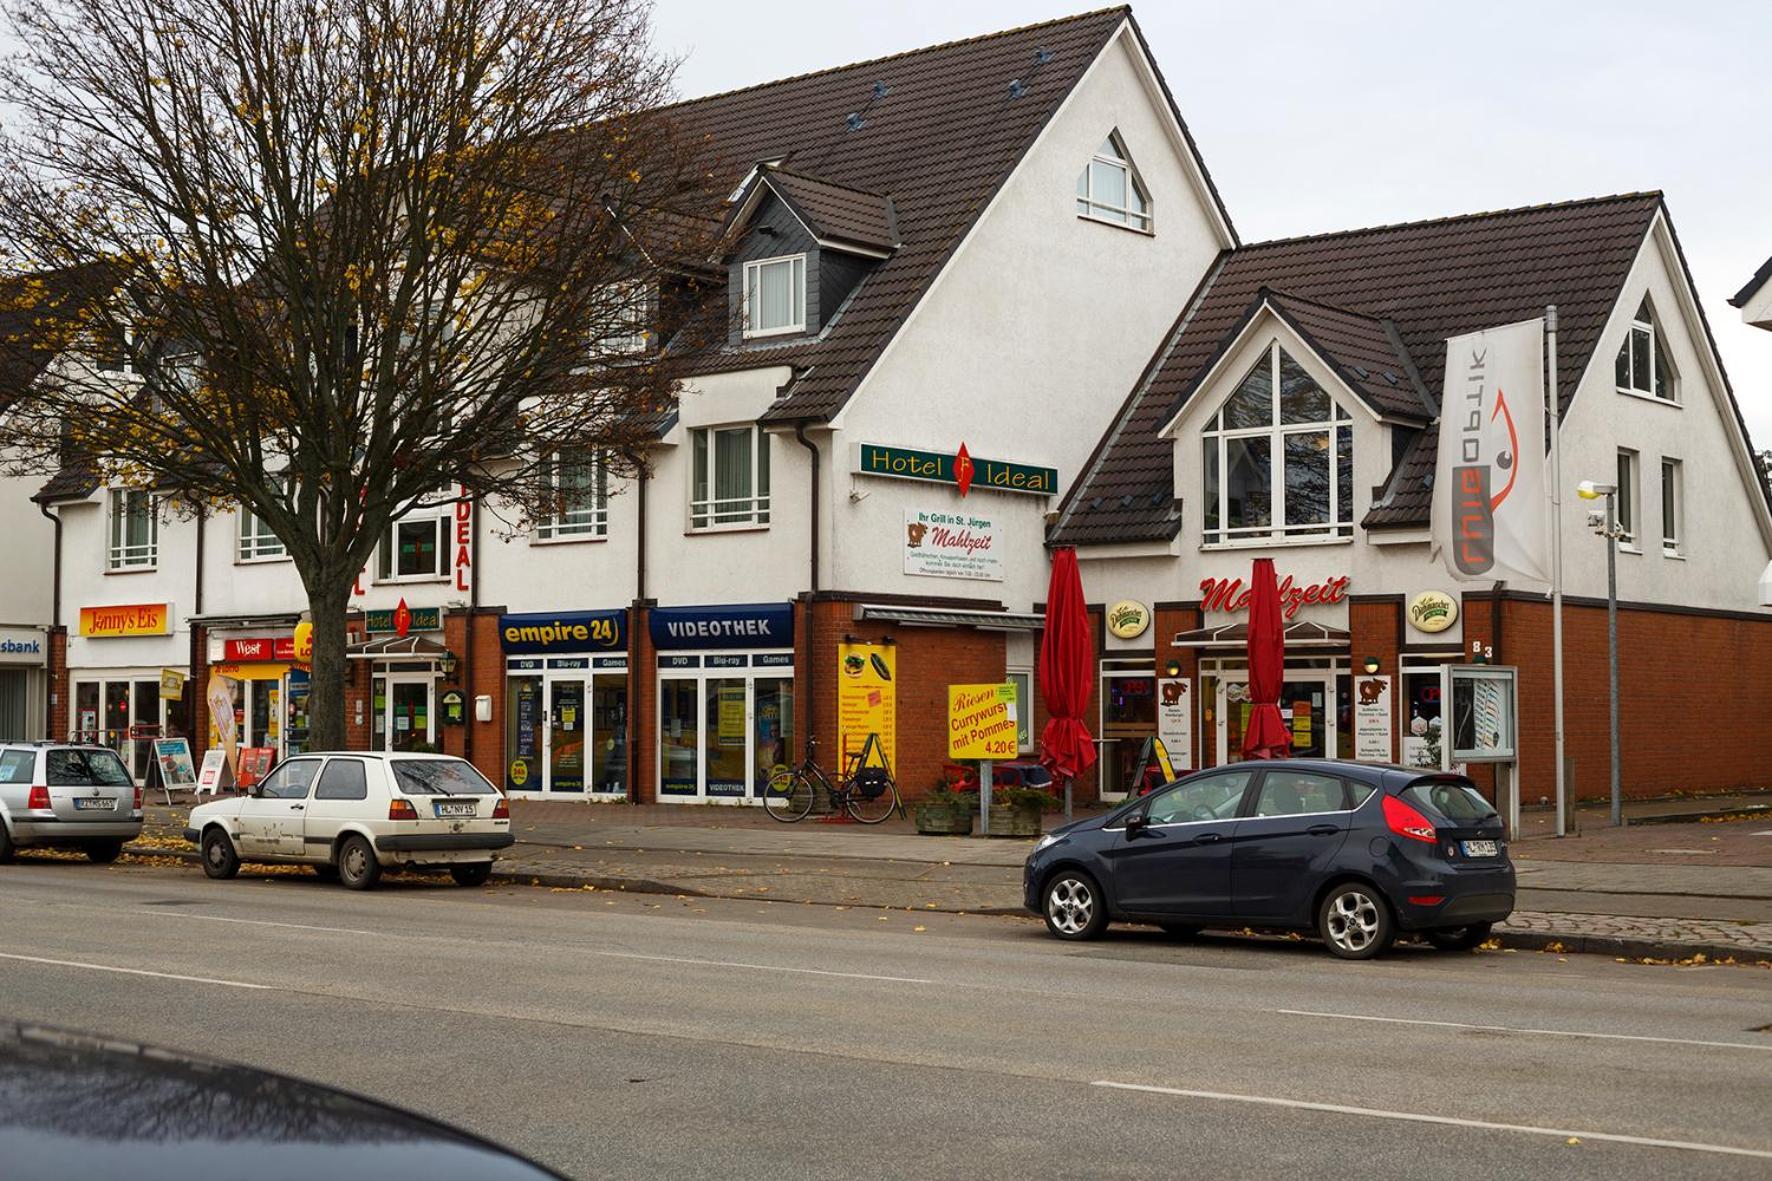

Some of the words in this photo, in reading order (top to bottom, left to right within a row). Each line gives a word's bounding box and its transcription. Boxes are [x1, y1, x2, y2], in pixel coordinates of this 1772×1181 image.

[872, 449, 942, 476] Hotel
[987, 463, 1049, 490] Ideal
[918, 512, 929, 521] Ihr
[930, 513, 946, 524] Grill
[947, 515, 954, 524] in
[955, 516, 965, 525] St.
[967, 517, 991, 529] Jürgen
[455, 482, 471, 591] IDEAL
[931, 526, 992, 555] Mahlzeit
[1199, 573, 1350, 619] Malzeit
[137, 607, 158, 628] Eis
[367, 612, 392, 628] Hotel
[412, 612, 439, 627] Ideal
[504, 621, 589, 646] empire
[590, 619, 612, 640] 24
[667, 618, 772, 637] VIDEOTHEK
[235, 640, 262, 656] West
[520, 660, 535, 668] DVD
[557, 660, 581, 669] Blu-ray
[602, 658, 626, 667] Games
[672, 657, 688, 665] DVD
[713, 656, 740, 666] Blu-ray
[762, 655, 789, 664] Games
[952, 688, 995, 713] Riesen
[951, 702, 1008, 731] Currywurst
[952, 734, 970, 751] mit
[970, 720, 1016, 742] Pommes
[709, 783, 745, 792] VIDEOTHEK
